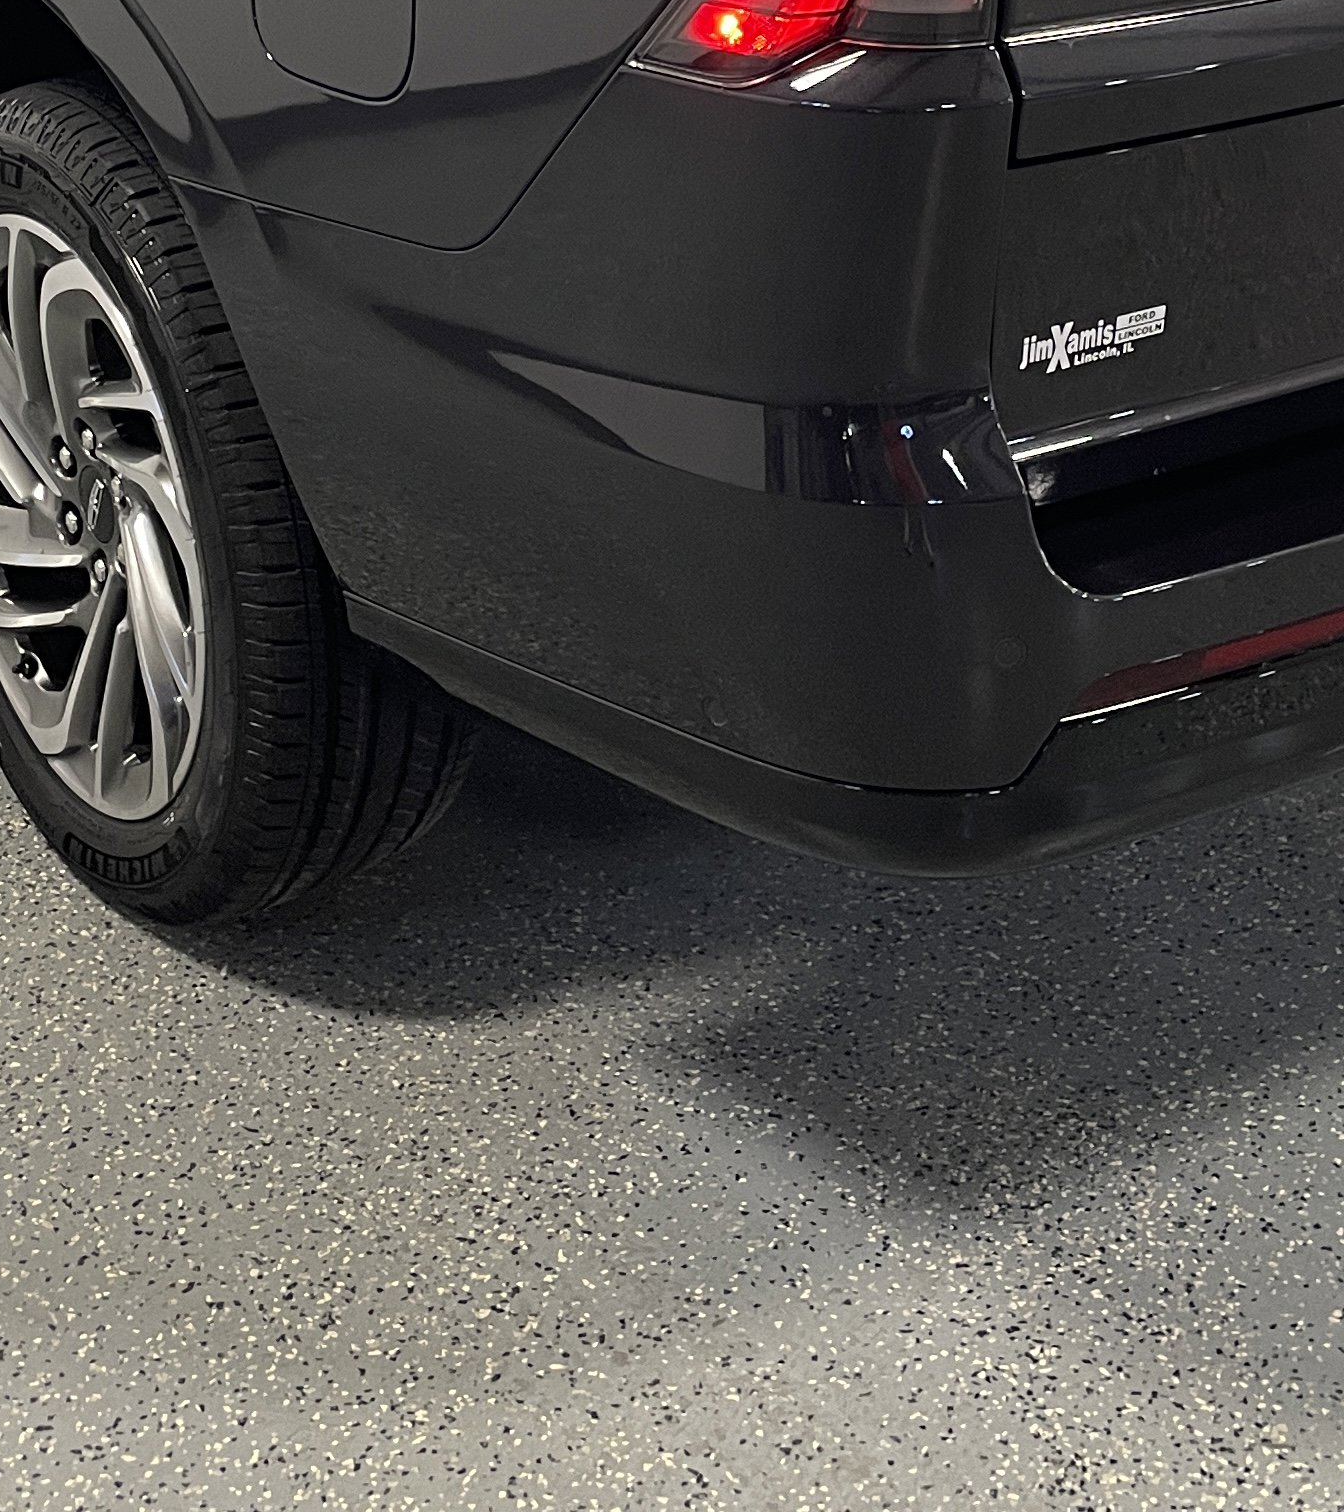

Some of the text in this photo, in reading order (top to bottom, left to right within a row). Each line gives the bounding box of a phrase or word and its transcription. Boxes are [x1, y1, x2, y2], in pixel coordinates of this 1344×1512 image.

[1128, 310, 1156, 325] FORD
[1118, 323, 1162, 341] LINCOLN
[1074, 342, 1135, 366] Lincoln, IL
